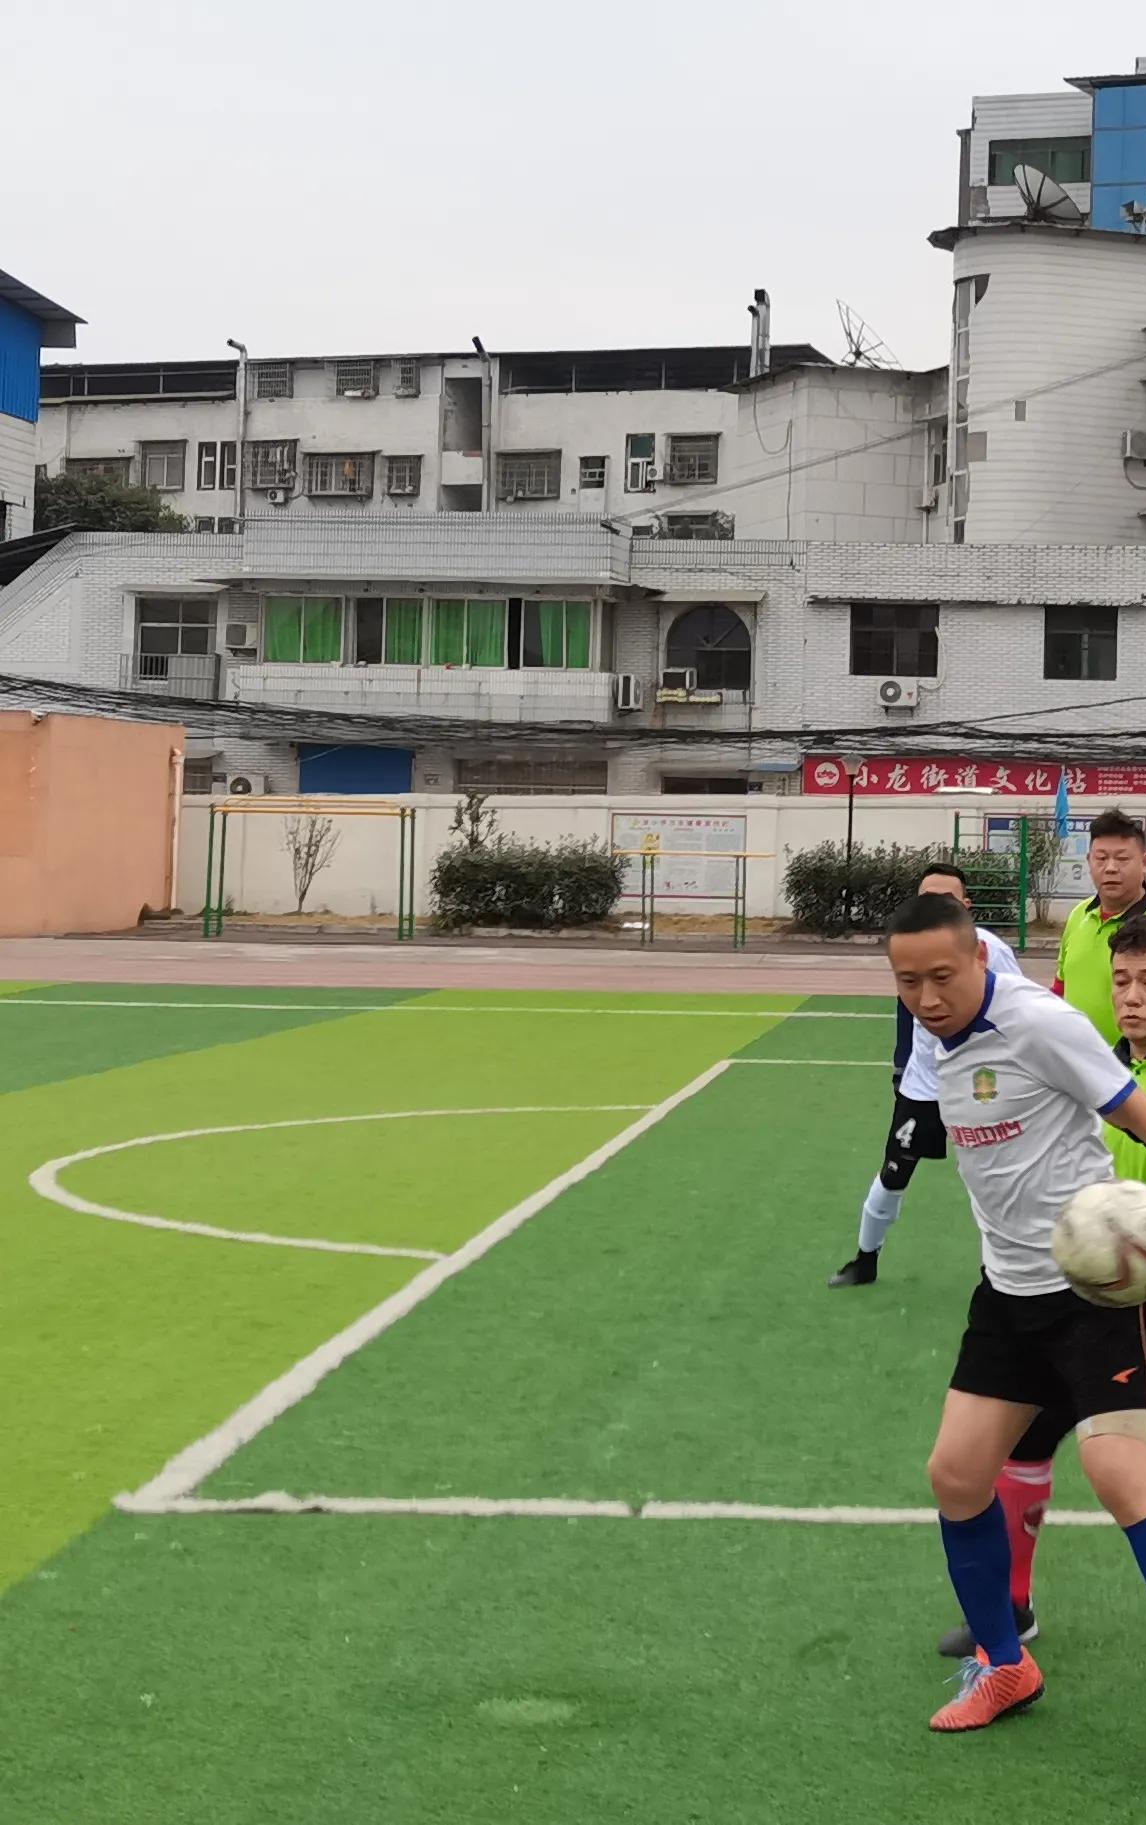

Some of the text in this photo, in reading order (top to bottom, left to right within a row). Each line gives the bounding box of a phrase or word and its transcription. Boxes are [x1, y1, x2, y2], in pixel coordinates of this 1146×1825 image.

[853, 763, 1087, 793] 小龙街道文化站
[896, 1118, 916, 1148] 4
